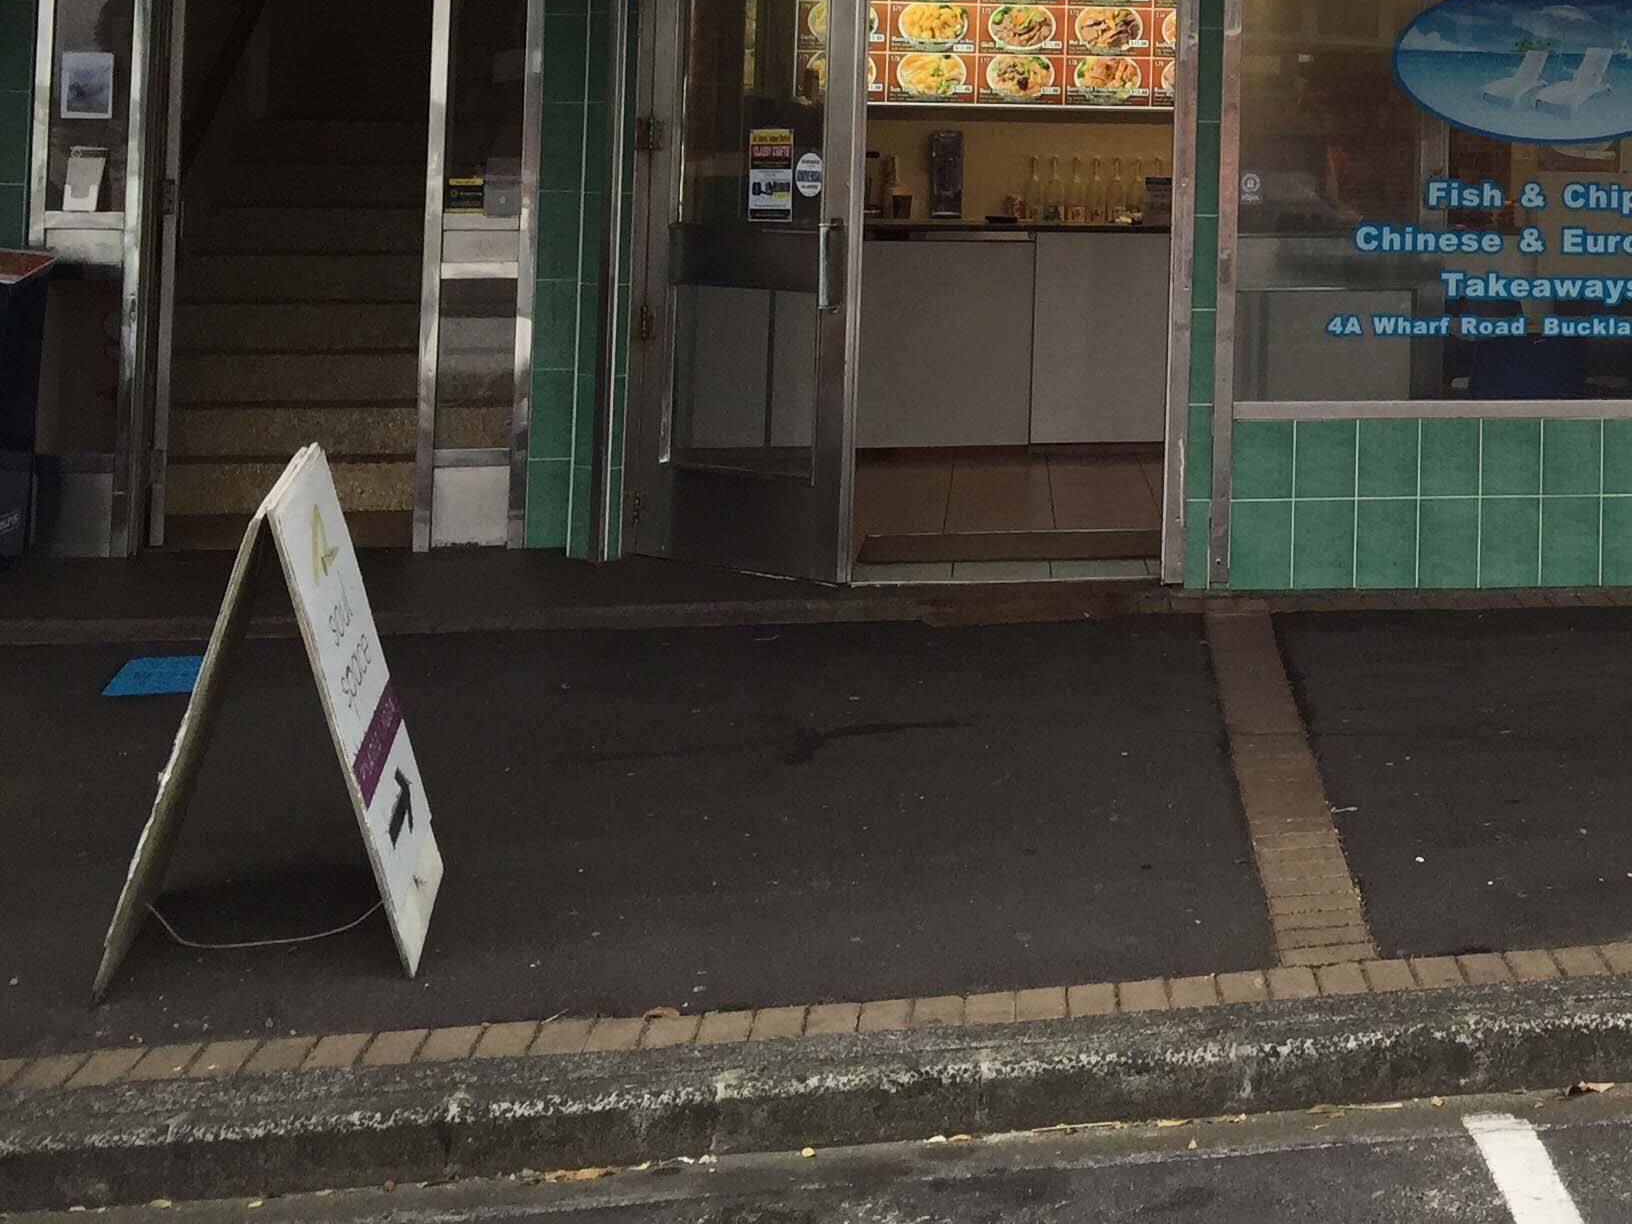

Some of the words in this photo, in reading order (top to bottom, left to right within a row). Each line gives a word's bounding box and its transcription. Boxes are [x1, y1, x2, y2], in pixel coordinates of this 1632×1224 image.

[1427, 181, 1503, 208] Fish
[1520, 183, 1547, 209] &
[1354, 225, 1503, 254] Chinese
[1518, 228, 1545, 254] &
[1327, 316, 1363, 336] 4A
[1373, 316, 1451, 337] Wharf
[1460, 317, 1527, 337] Road
